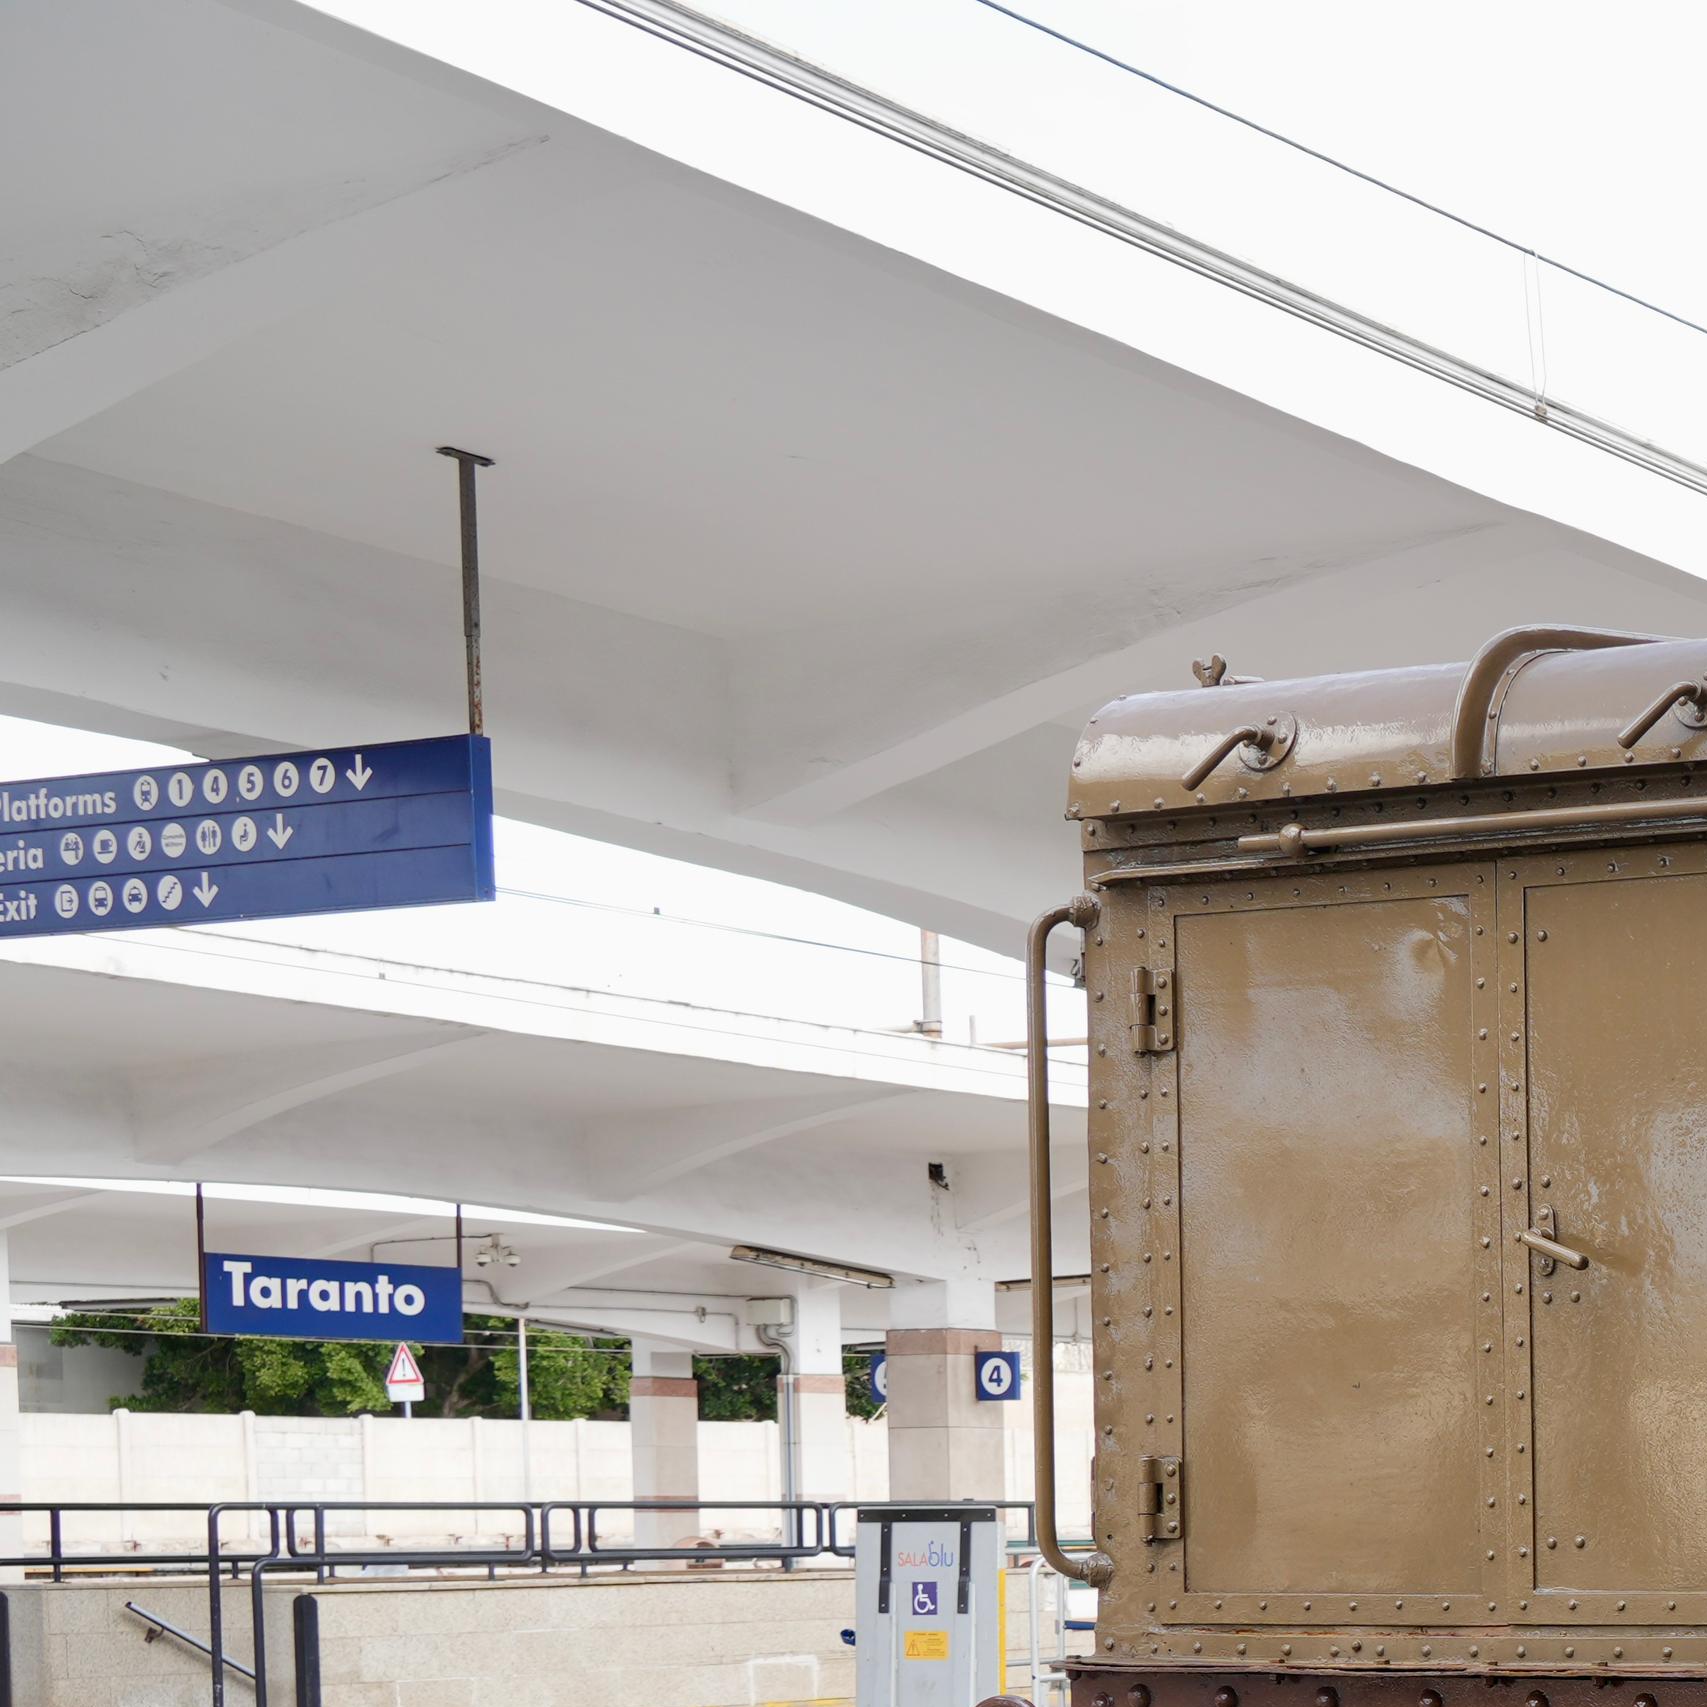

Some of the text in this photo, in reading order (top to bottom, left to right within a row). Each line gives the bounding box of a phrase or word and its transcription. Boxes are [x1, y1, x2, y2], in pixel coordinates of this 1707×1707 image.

[0, 787, 117, 822] latforms
[211, 775, 221, 797] 4
[246, 772, 256, 793] 5
[281, 768, 292, 790] 6
[317, 765, 328, 787] 7
[223, 1260, 426, 1316] Taranto
[988, 1365, 1003, 1387] 4
